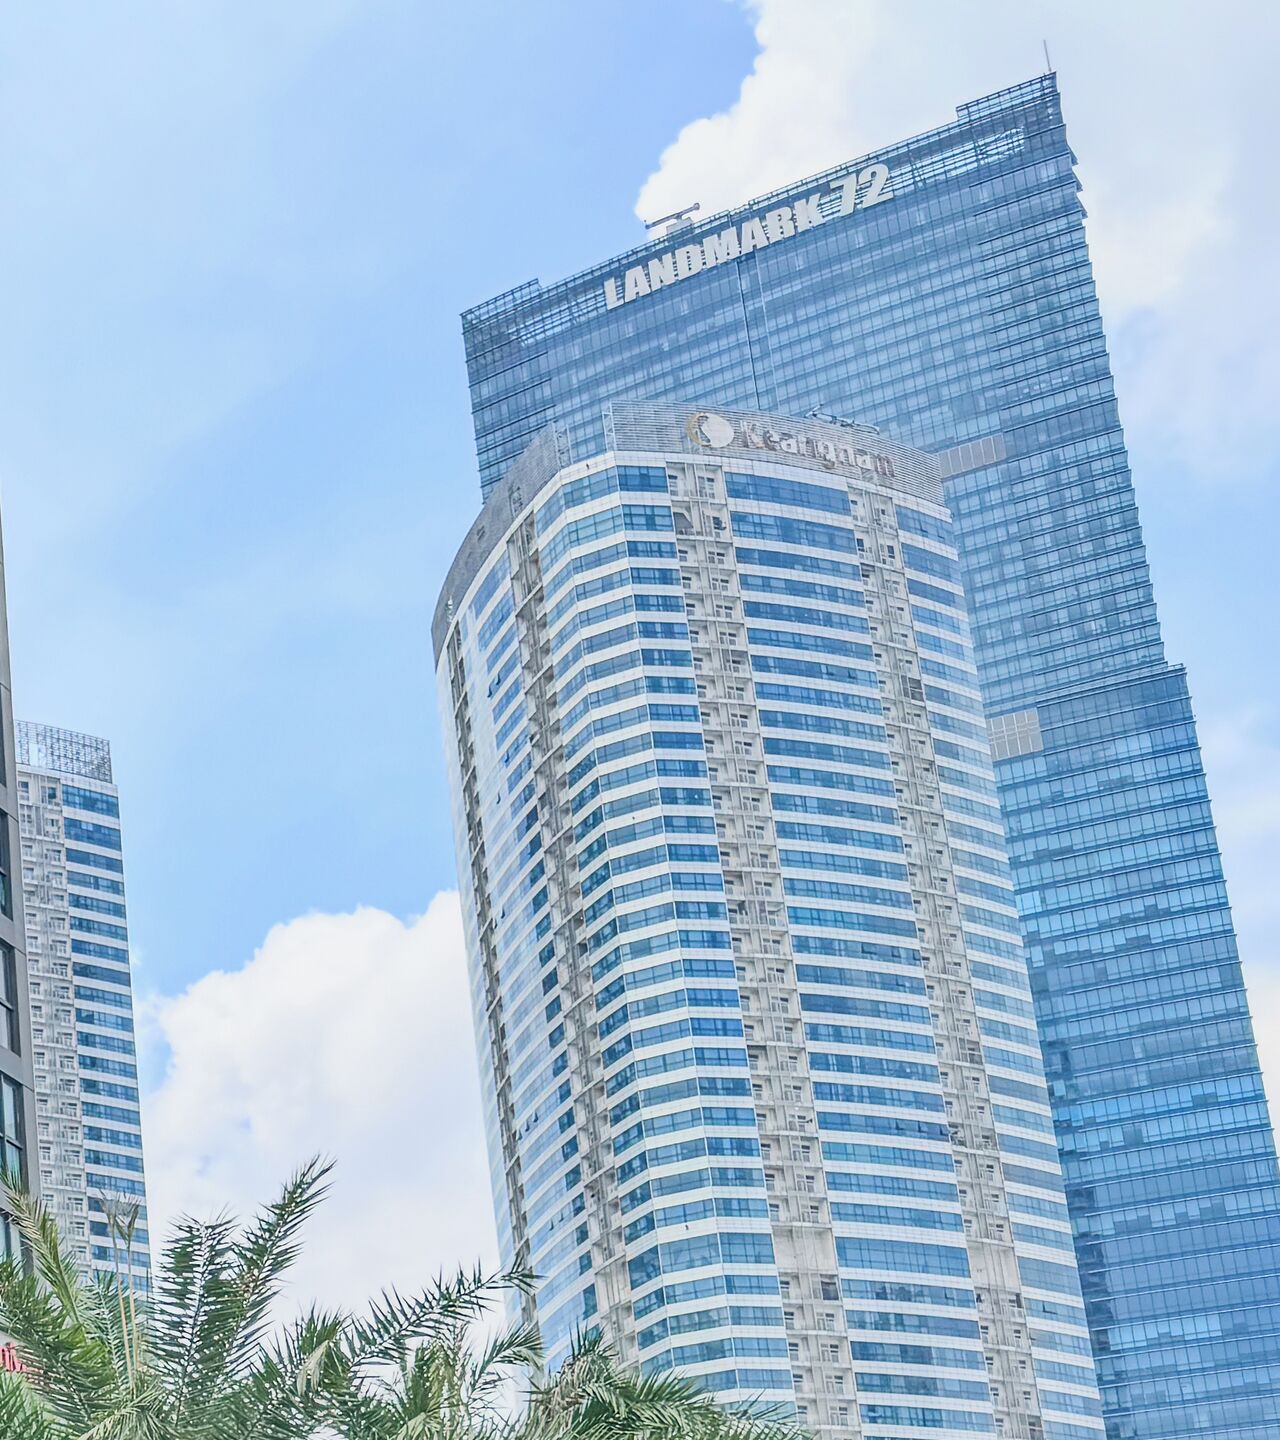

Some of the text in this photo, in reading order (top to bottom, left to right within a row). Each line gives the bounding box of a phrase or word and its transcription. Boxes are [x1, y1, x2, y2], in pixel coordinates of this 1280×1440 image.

[603, 163, 894, 310] LANDMARK 72
[740, 419, 895, 478] Keangnam
